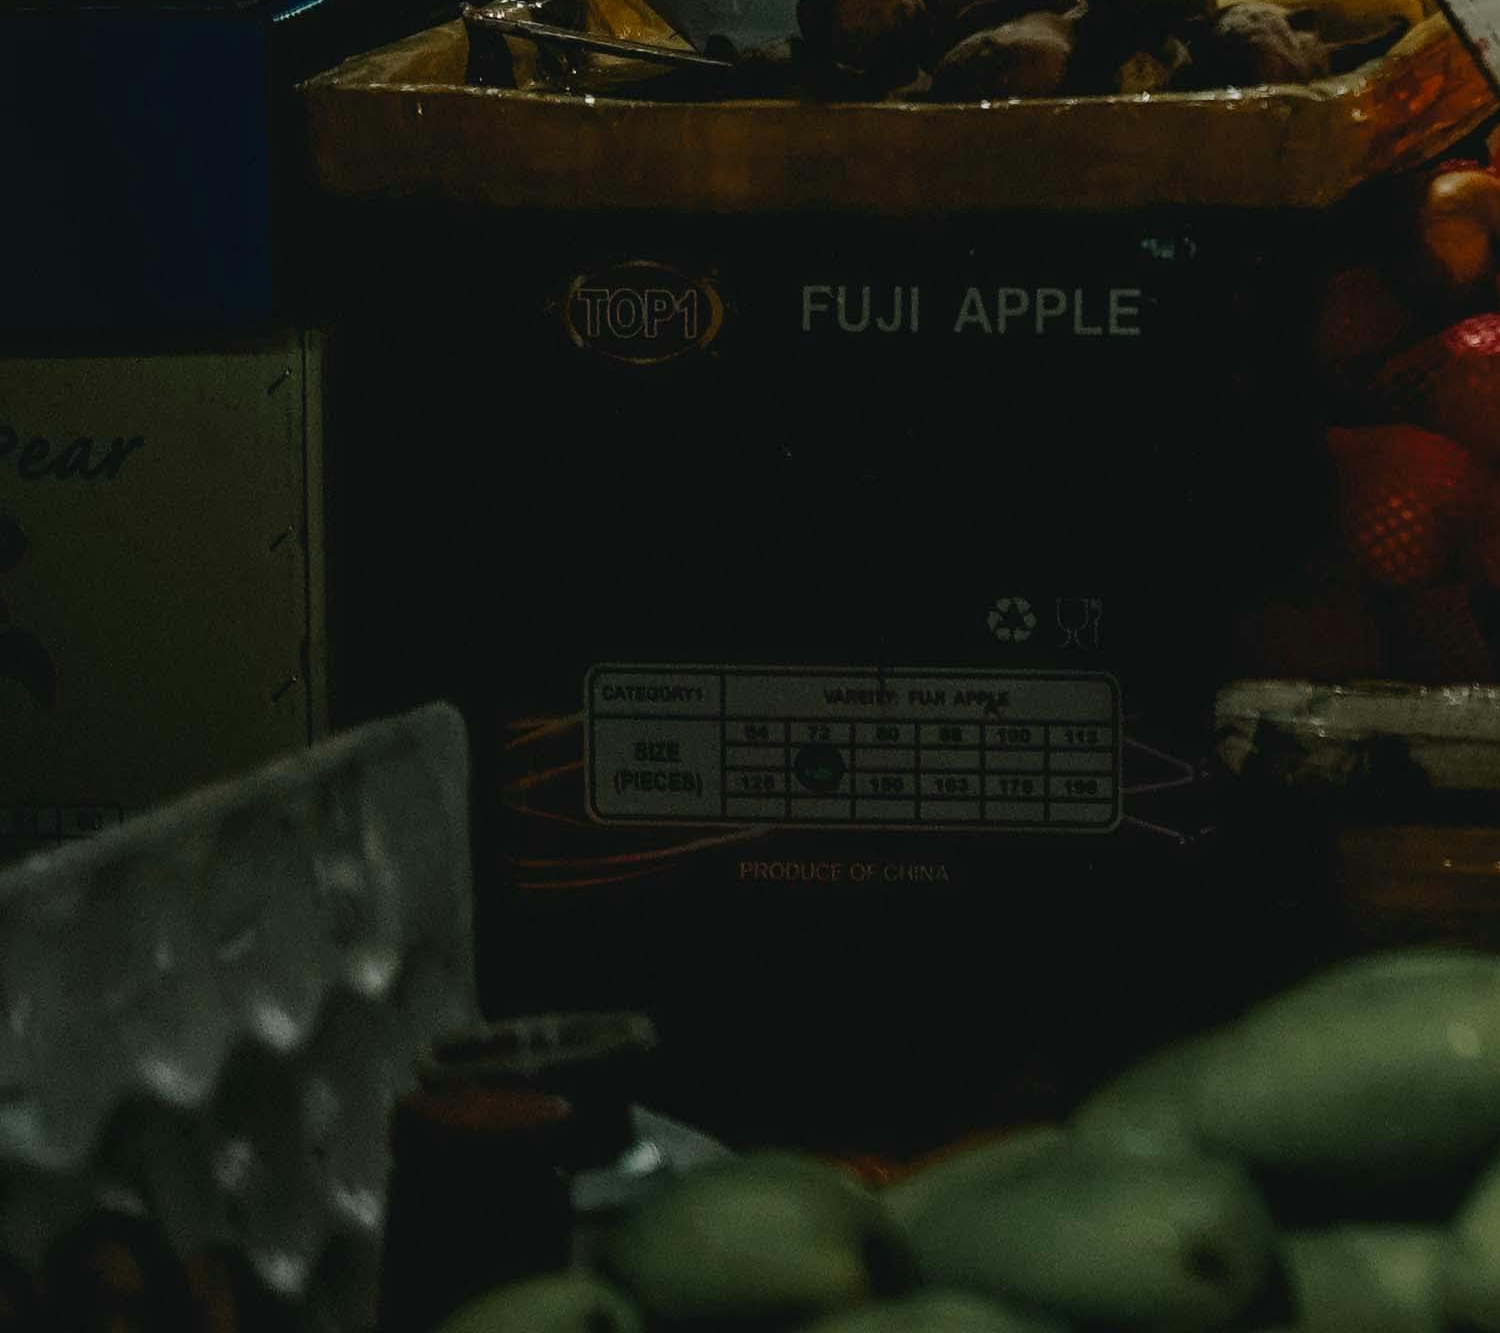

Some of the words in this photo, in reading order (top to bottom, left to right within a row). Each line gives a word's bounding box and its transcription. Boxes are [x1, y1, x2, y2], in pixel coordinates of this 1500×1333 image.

[578, 289, 698, 340] TOP1
[801, 285, 921, 334] FUJI
[954, 286, 1142, 336] APPLE
[908, 689, 946, 705] FUJI
[954, 689, 1010, 706] APPLE
[634, 740, 681, 762] SIZE
[614, 769, 703, 797] (PIECES)
[739, 860, 841, 882] PRODUCE
[849, 862, 873, 882] OF
[882, 863, 950, 884] CHINA
